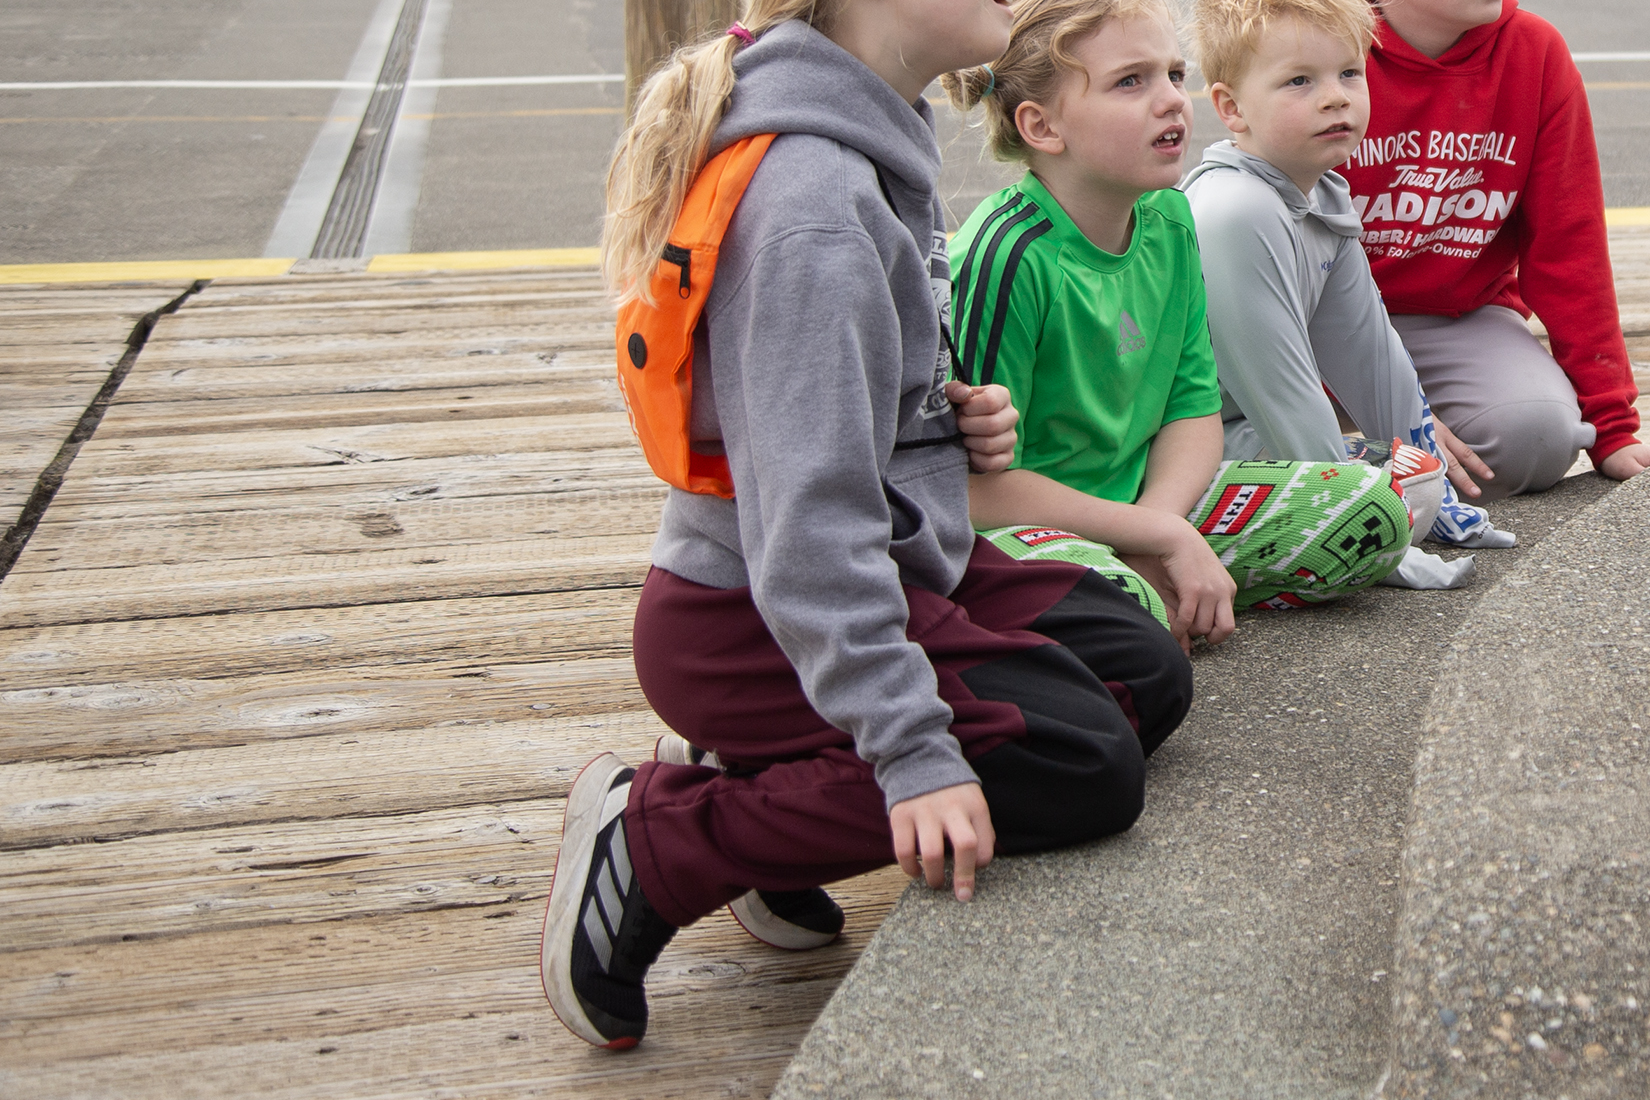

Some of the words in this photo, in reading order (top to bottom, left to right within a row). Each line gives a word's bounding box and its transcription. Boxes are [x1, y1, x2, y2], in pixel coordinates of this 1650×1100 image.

[1346, 130, 1421, 170] MINORS
[1427, 130, 1517, 166] BASEBALL
[1219, 491, 1253, 527] TNT
